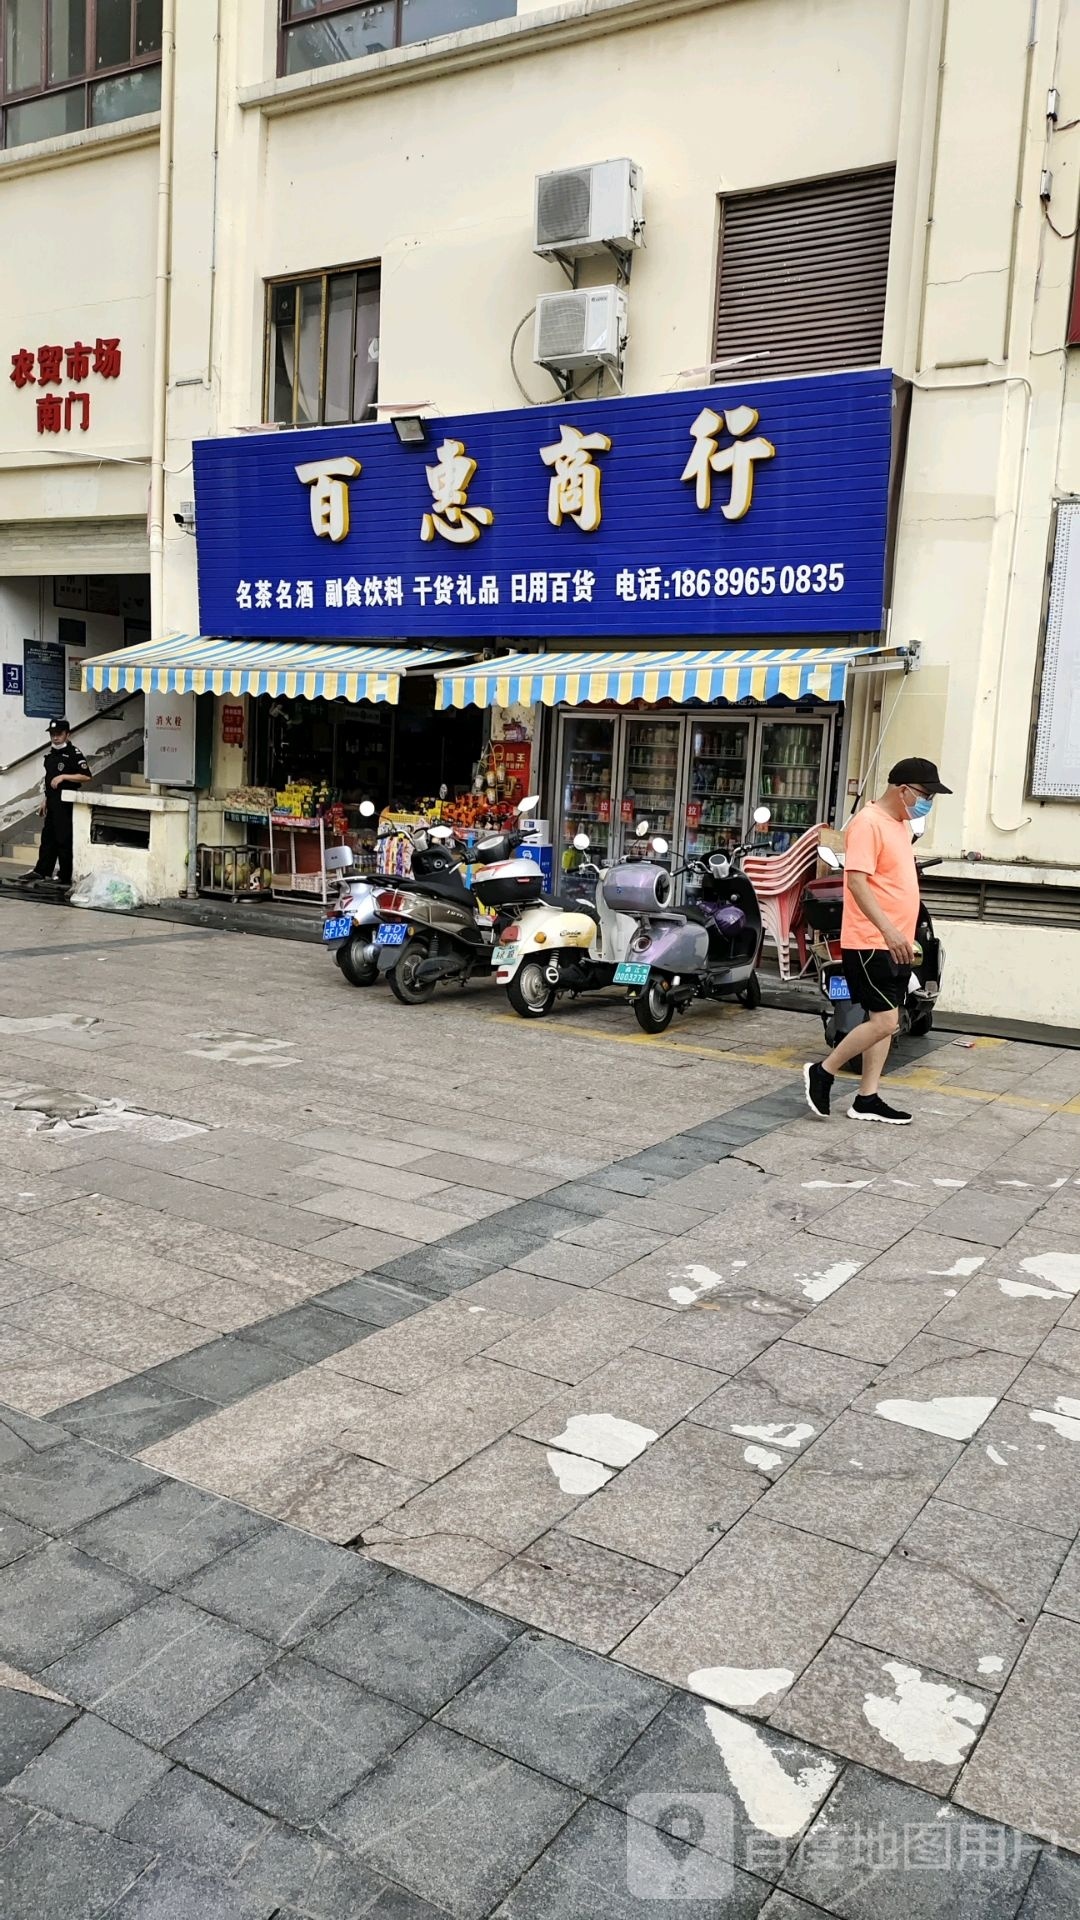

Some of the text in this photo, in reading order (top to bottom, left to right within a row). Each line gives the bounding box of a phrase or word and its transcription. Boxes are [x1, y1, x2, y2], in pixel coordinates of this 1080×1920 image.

[9, 338, 121, 388] 农贸市场
[36, 391, 90, 434] 南门
[294, 404, 776, 545] 百惠商行
[236, 580, 314, 609] 名茶名酒
[325, 575, 404, 609] 副食饮料
[413, 574, 500, 607] 干货礼品
[511, 569, 596, 603] 日用百货
[155, 715, 182, 727] 消火栓
[325, 926, 349, 939] 5F126
[377, 933, 403, 944] 54796
[831, 987, 850, 997] 000
